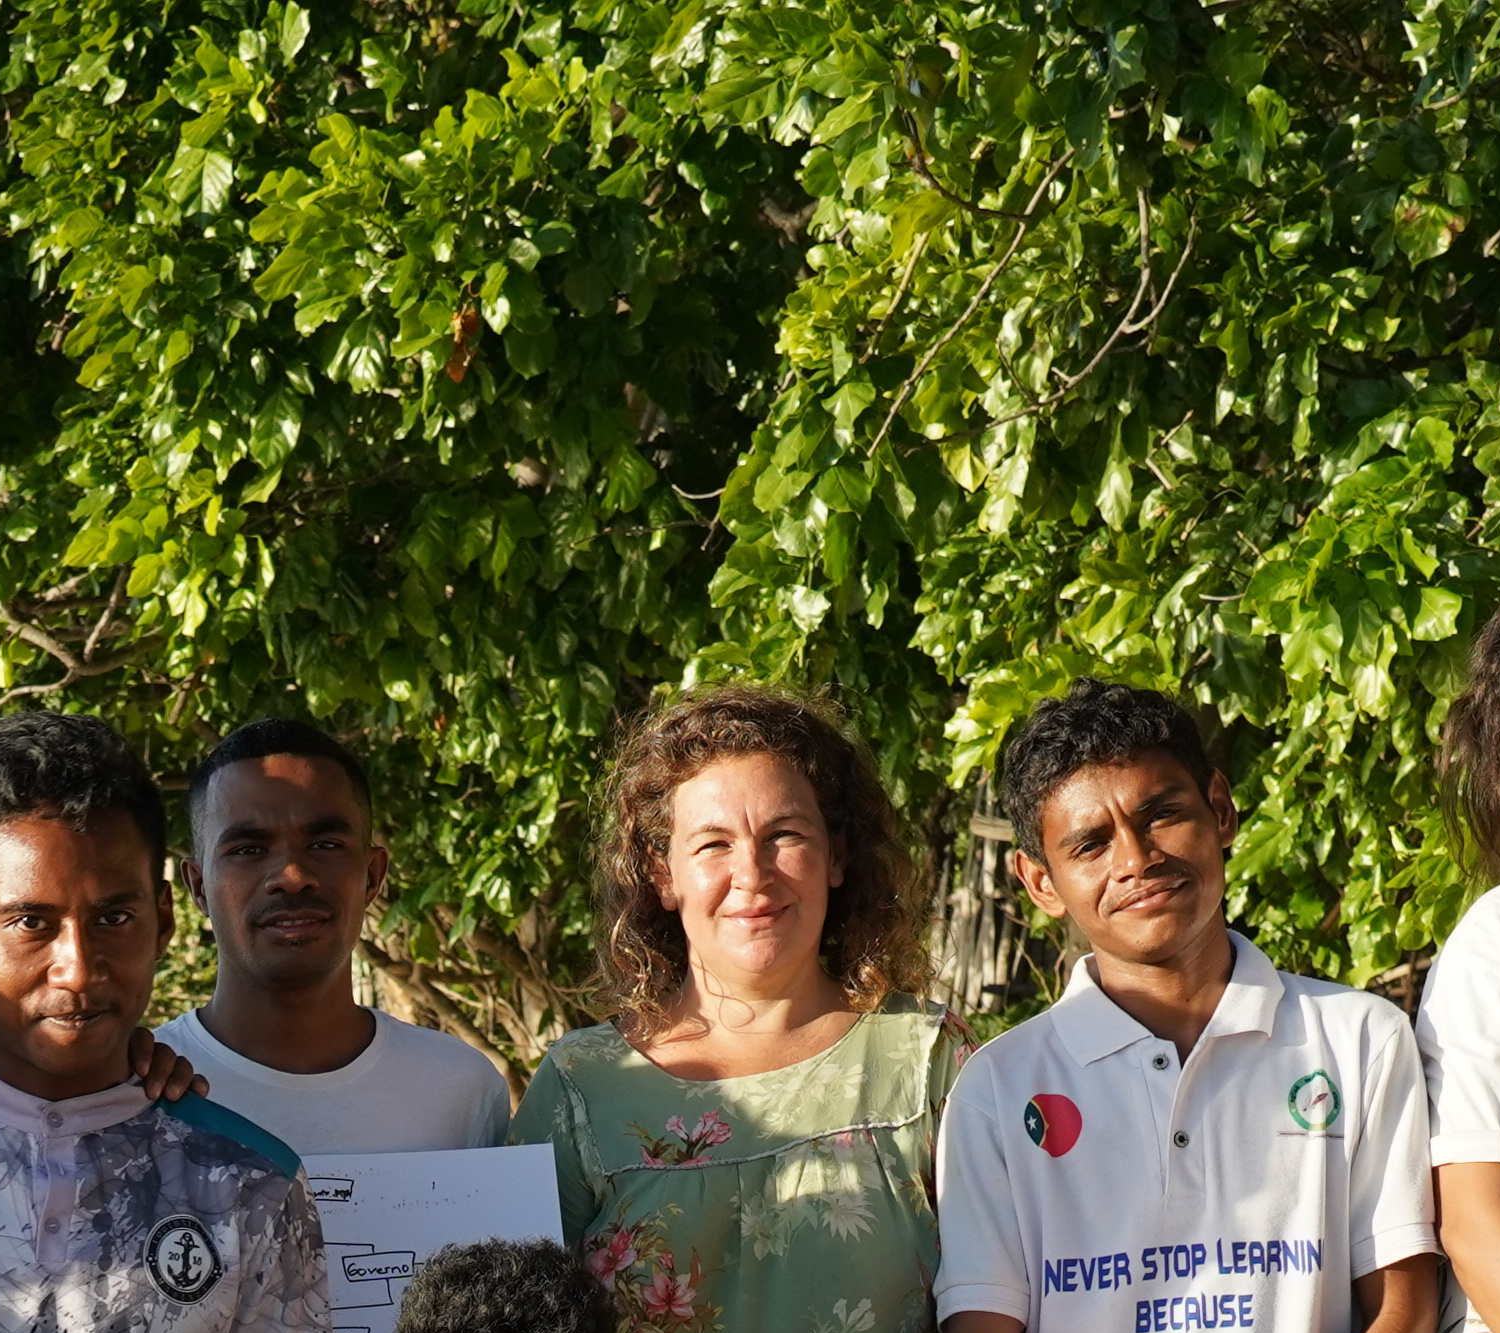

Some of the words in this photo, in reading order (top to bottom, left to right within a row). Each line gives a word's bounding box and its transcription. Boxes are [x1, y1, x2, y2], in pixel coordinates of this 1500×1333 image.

[347, 1263, 409, 1277] Governo
[1044, 1253, 1132, 1297] NEVER
[1140, 1238, 1207, 1284] STOP
[1217, 1237, 1325, 1278] LEARNIN
[1135, 1293, 1254, 1333] BECAUSE
